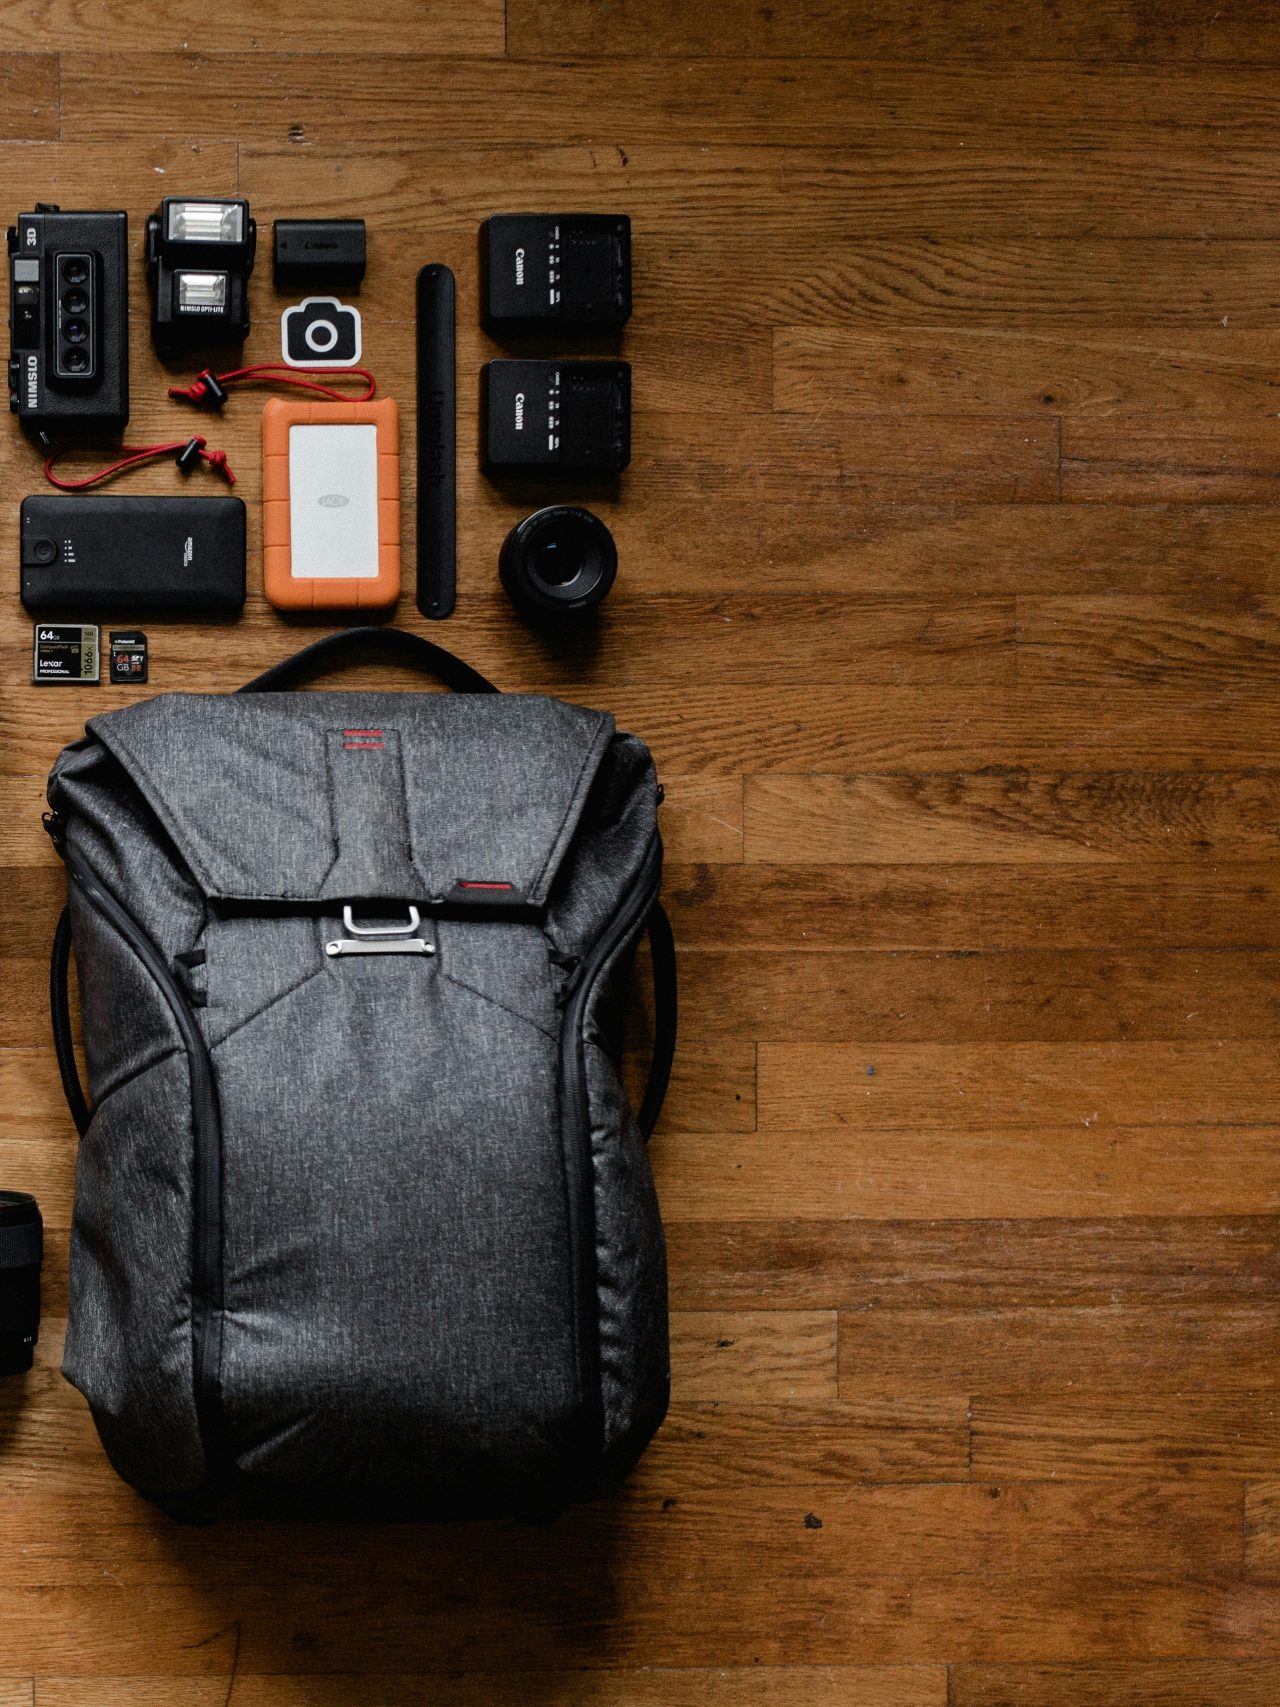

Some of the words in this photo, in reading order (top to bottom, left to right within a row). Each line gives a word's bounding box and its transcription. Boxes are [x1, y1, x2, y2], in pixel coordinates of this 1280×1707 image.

[26, 227, 37, 247] 3D
[304, 241, 339, 251] Canon
[515, 248, 525, 285] Canon
[179, 304, 200, 312] NIMSLO
[27, 355, 38, 409] NIMSLO
[514, 393, 525, 431] Canon
[39, 659, 63, 668] Lexar
[116, 655, 129, 664] 64
[116, 664, 130, 672] GB
